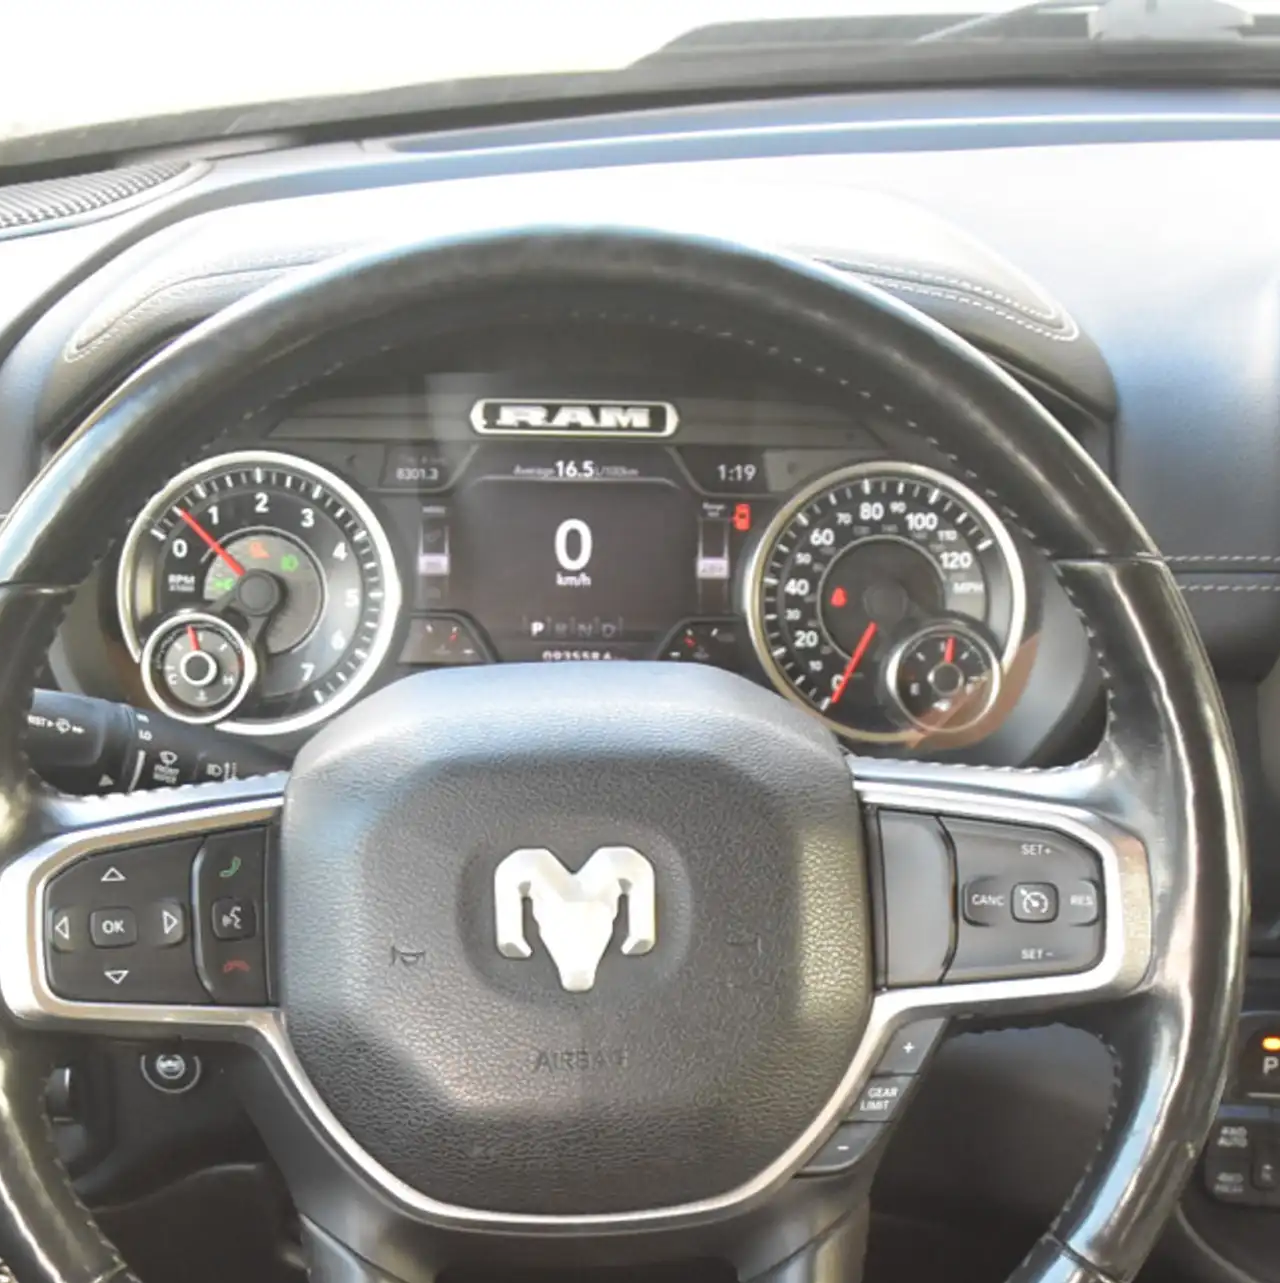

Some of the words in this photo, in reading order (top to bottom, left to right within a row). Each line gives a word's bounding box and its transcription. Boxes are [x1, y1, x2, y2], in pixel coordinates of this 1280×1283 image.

[495, 404, 651, 429] RAM
[556, 459, 594, 478] 16.5
[717, 464, 757, 482] 1:19
[255, 493, 269, 512] 2
[859, 502, 884, 521] 80
[889, 502, 907, 515] 90
[208, 506, 219, 524] 1
[301, 508, 315, 527] 3
[836, 513, 853, 526] 70
[904, 512, 939, 531] 100
[554, 518, 593, 570] 0
[809, 528, 835, 546] 60
[172, 538, 188, 557] 0
[332, 542, 348, 561] 4
[939, 551, 973, 570] 120
[555, 572, 592, 588] km/h
[784, 579, 810, 596] 40
[345, 588, 359, 607] 5
[530, 621, 545, 637] P
[331, 636, 346, 657] 6
[794, 630, 819, 648] 20
[301, 663, 316, 682] 7
[971, 893, 1006, 906] CANC
[101, 919, 126, 934] OK
[1262, 1056, 1280, 1075] P
[859, 1100, 891, 1112] LIMIT
